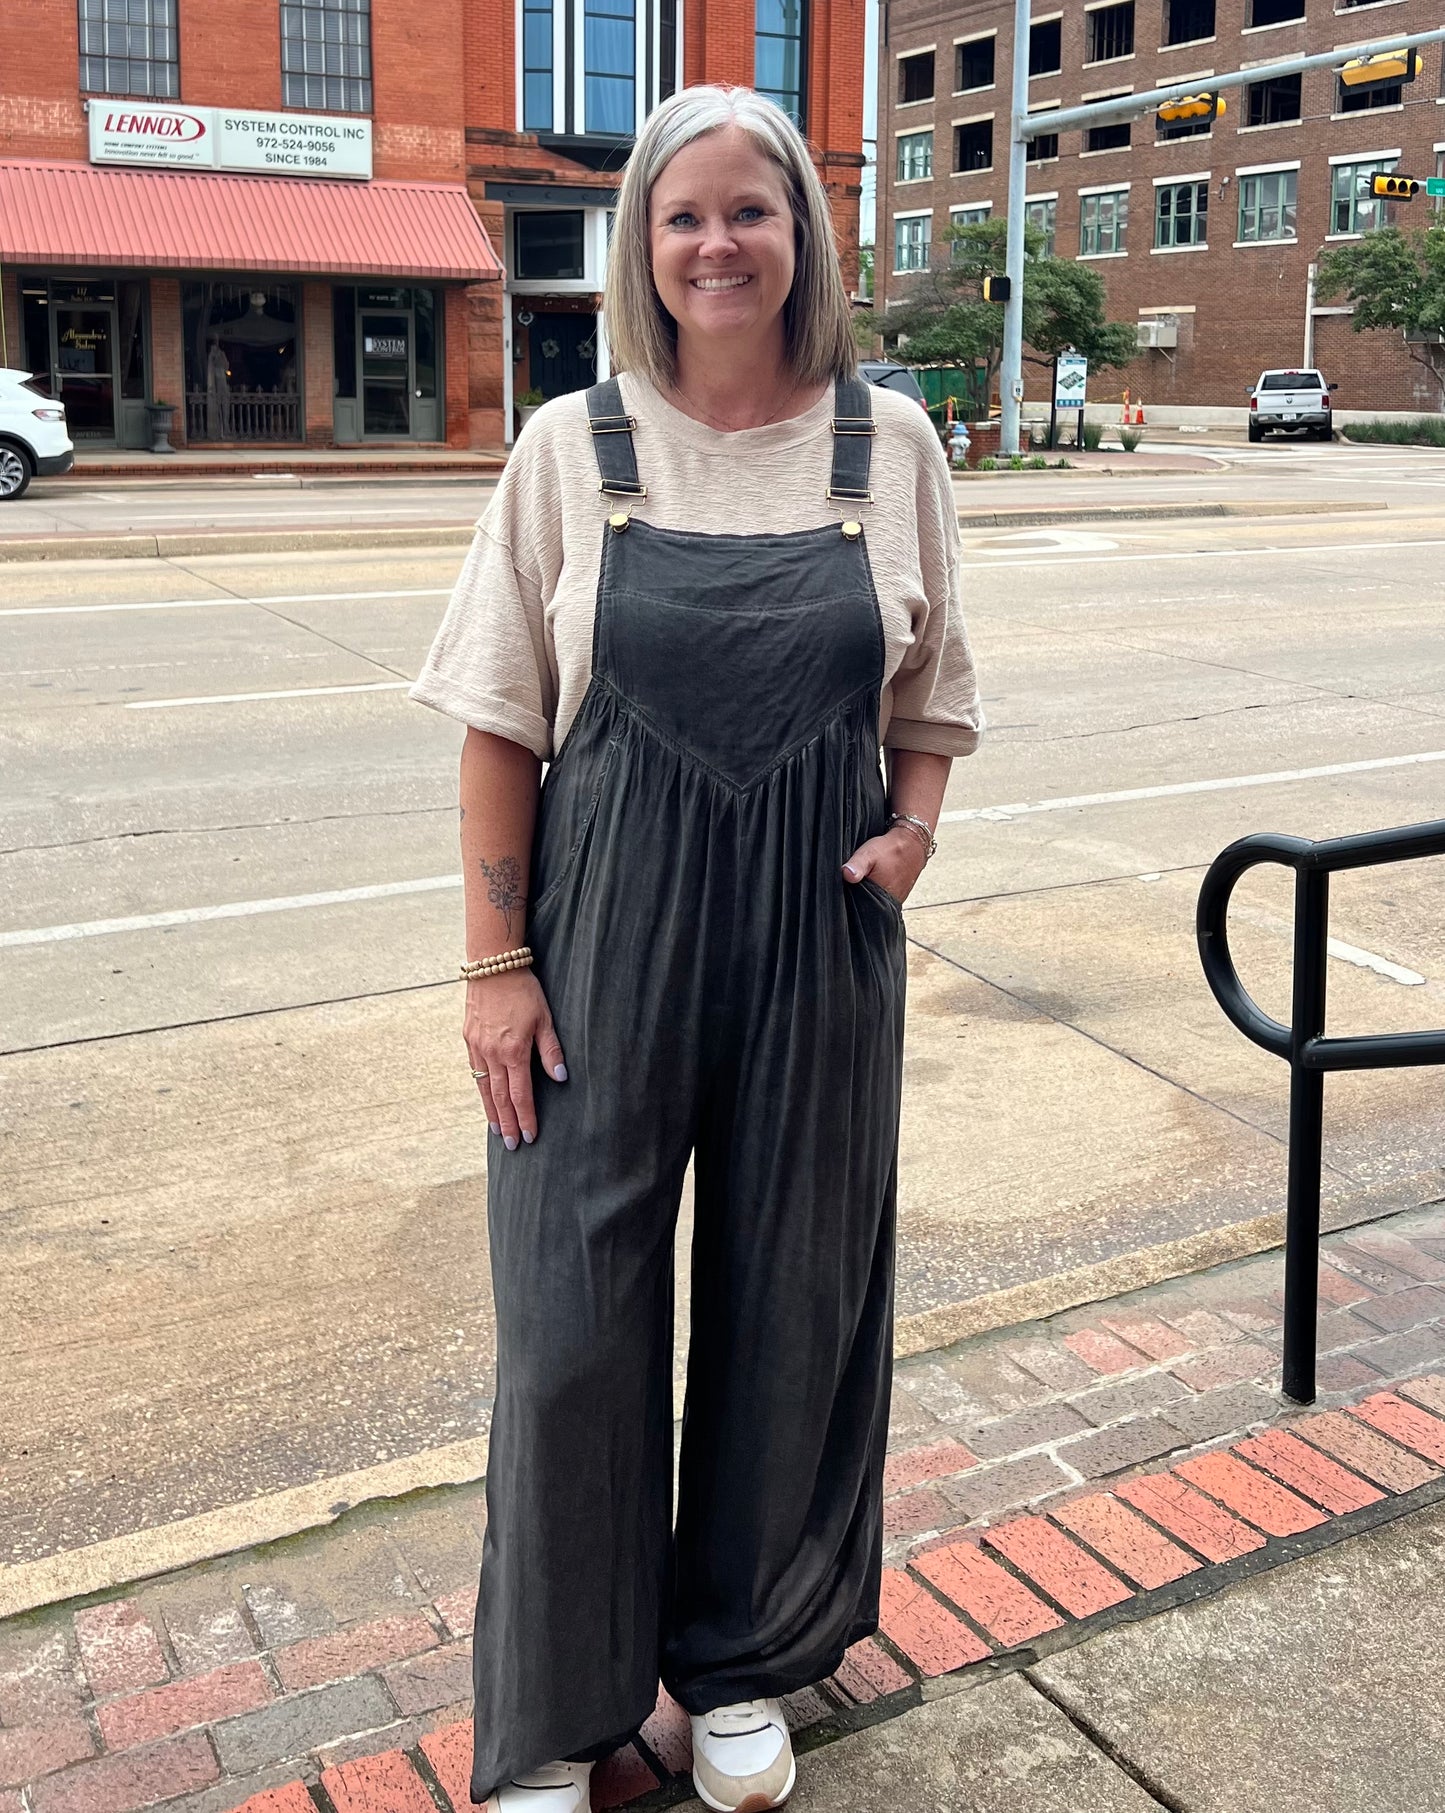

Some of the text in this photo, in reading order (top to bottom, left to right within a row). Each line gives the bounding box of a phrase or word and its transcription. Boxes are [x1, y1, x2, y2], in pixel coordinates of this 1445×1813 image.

[104, 113, 186, 137] LENNOX
[225, 119, 365, 140] SYSTEM CONTROL INC
[104, 148, 139, 156] Innovation
[256, 137, 336, 153] 972-524-9056
[265, 152, 327, 166] SINCE 1984
